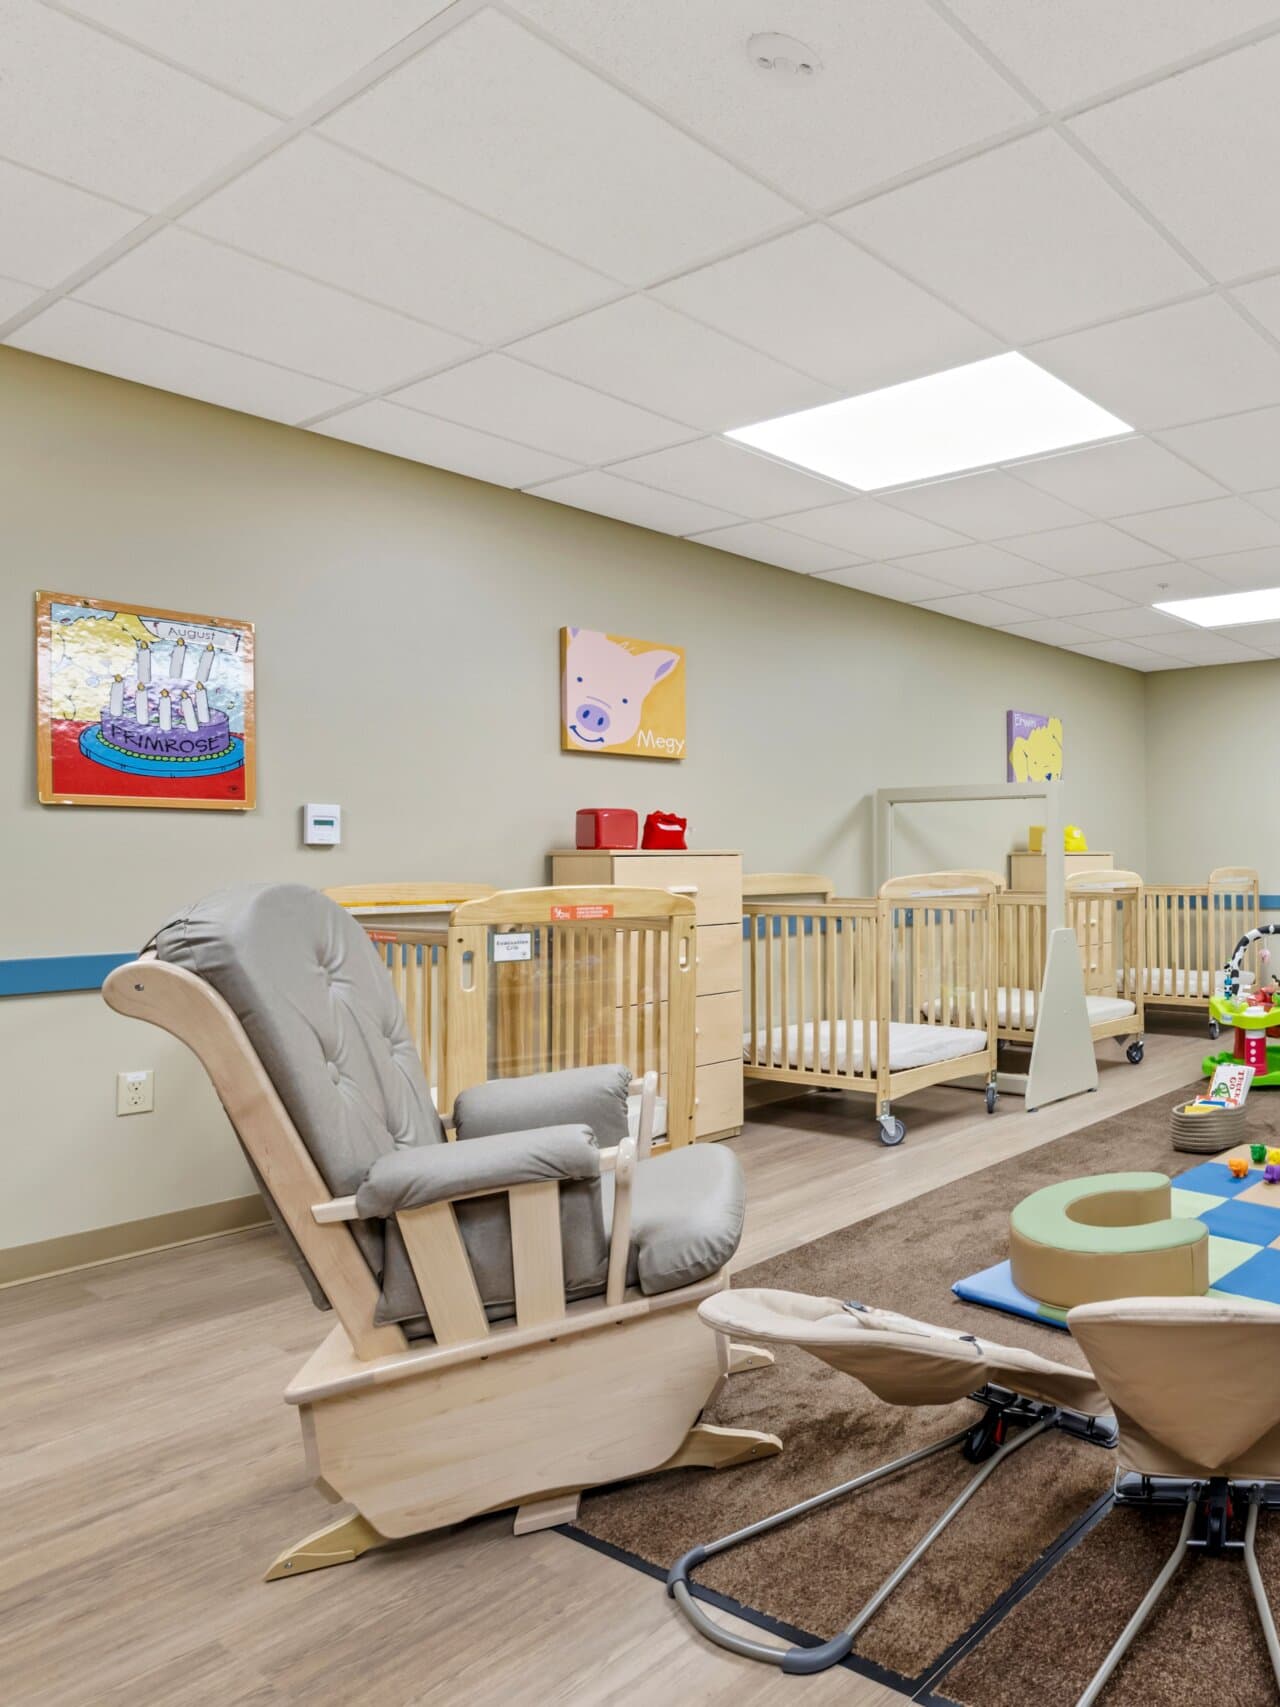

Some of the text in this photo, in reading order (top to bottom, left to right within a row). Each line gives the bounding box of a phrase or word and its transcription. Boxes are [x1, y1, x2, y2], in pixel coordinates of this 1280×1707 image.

[168, 626, 215, 641] August
[111, 724, 221, 754] PRIMROSE
[636, 728, 685, 756] Megy
